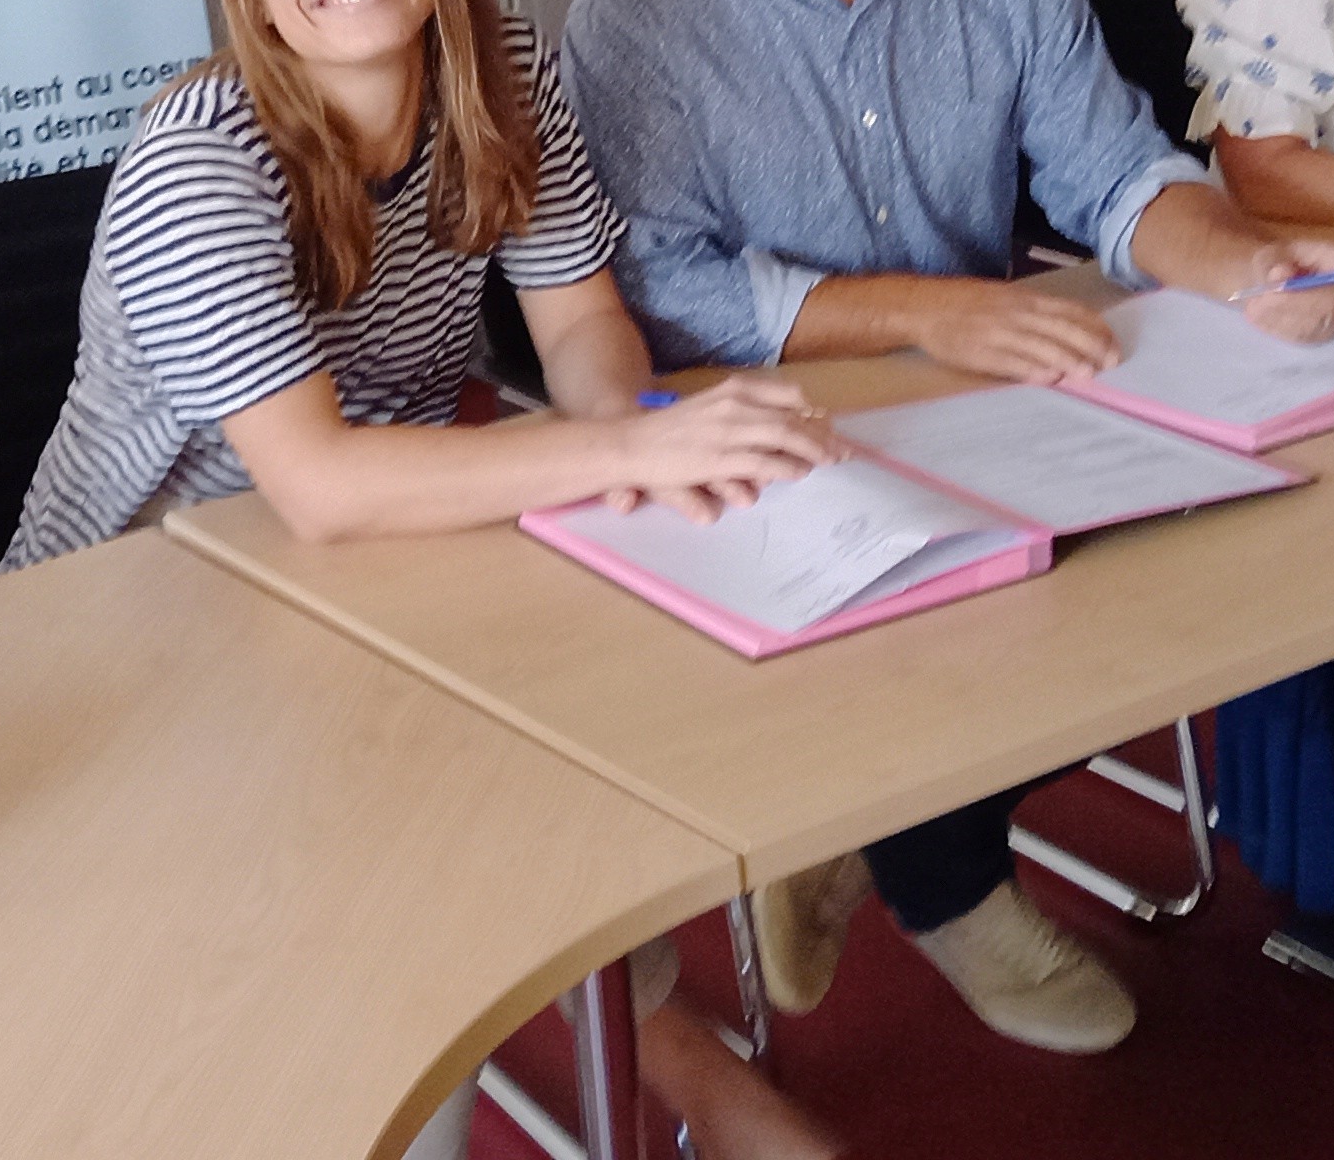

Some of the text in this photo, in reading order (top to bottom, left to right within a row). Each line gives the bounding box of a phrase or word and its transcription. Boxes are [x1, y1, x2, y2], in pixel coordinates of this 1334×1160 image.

[76, 71, 114, 100] au
[34, 106, 134, 144] démar
[57, 145, 90, 173] et
